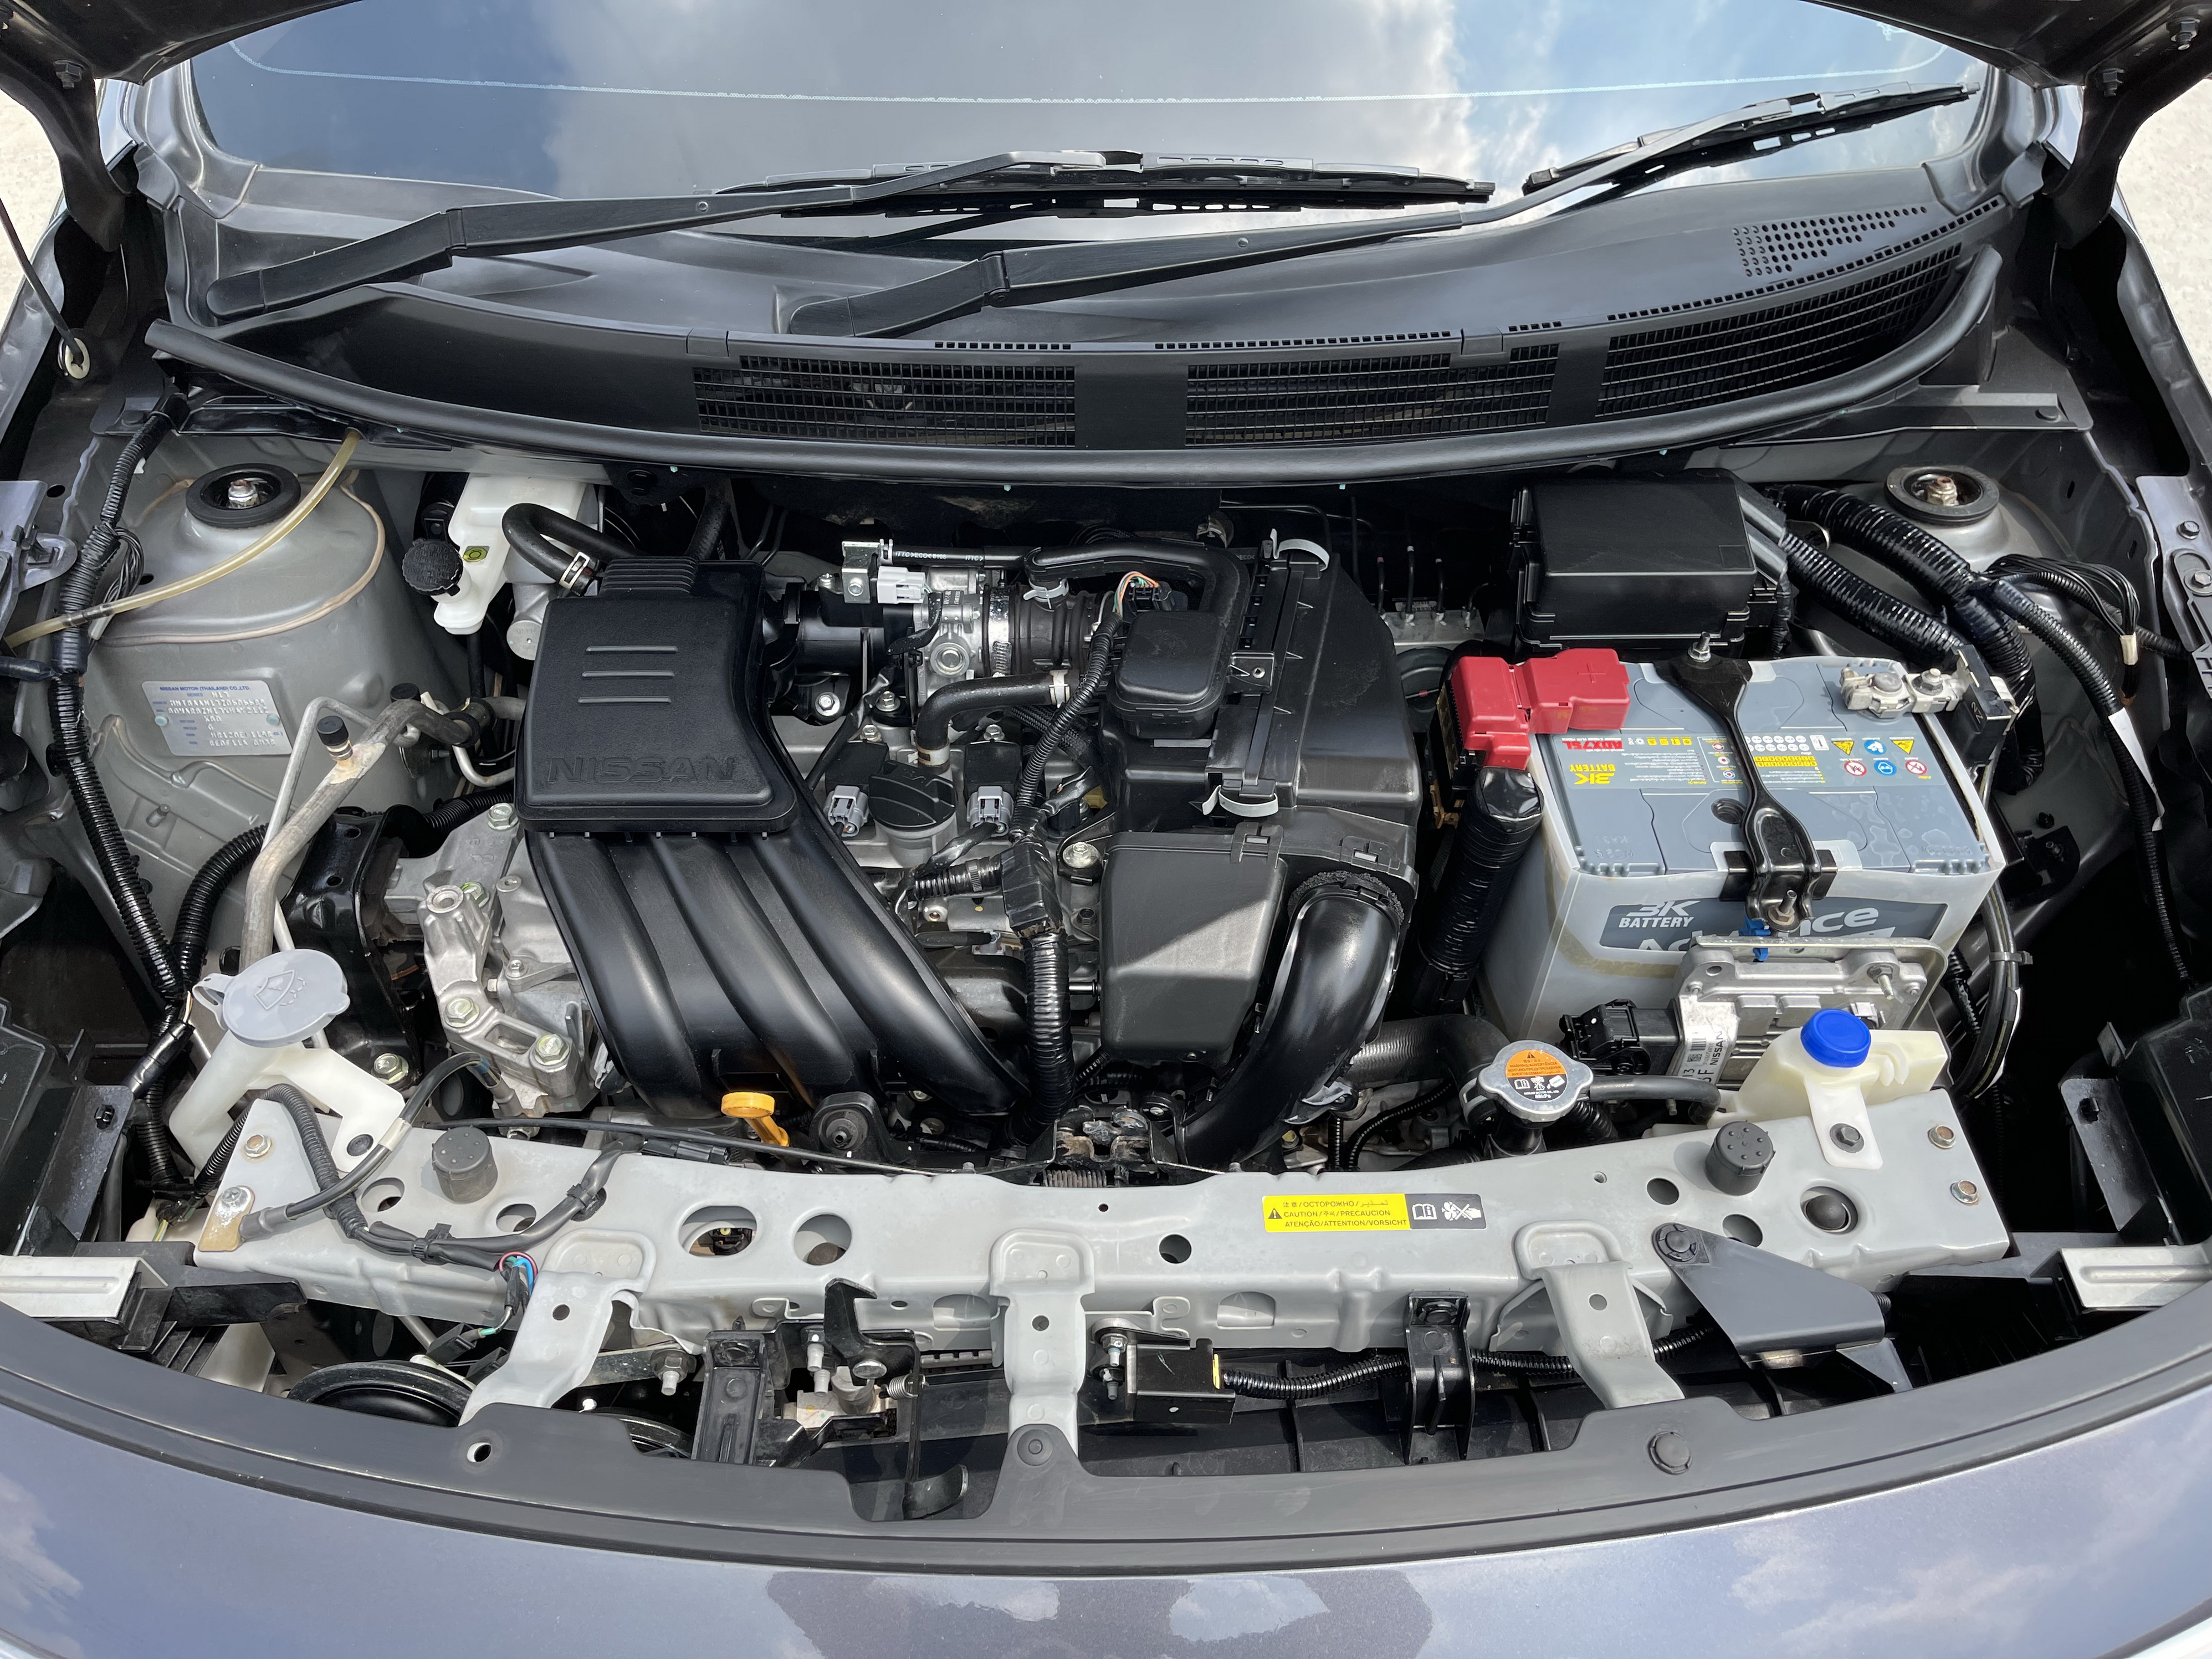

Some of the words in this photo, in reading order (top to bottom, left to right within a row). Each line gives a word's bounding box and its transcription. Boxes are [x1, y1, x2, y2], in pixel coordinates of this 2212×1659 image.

[548, 756, 735, 784] NISSAN
[1570, 764, 1616, 772] BATTERY
[1574, 772, 1615, 785] 3K
[1626, 900, 1701, 916] 3K
[1618, 916, 1694, 928] BATTERY
[1710, 1031, 1724, 1065] NISSAN
